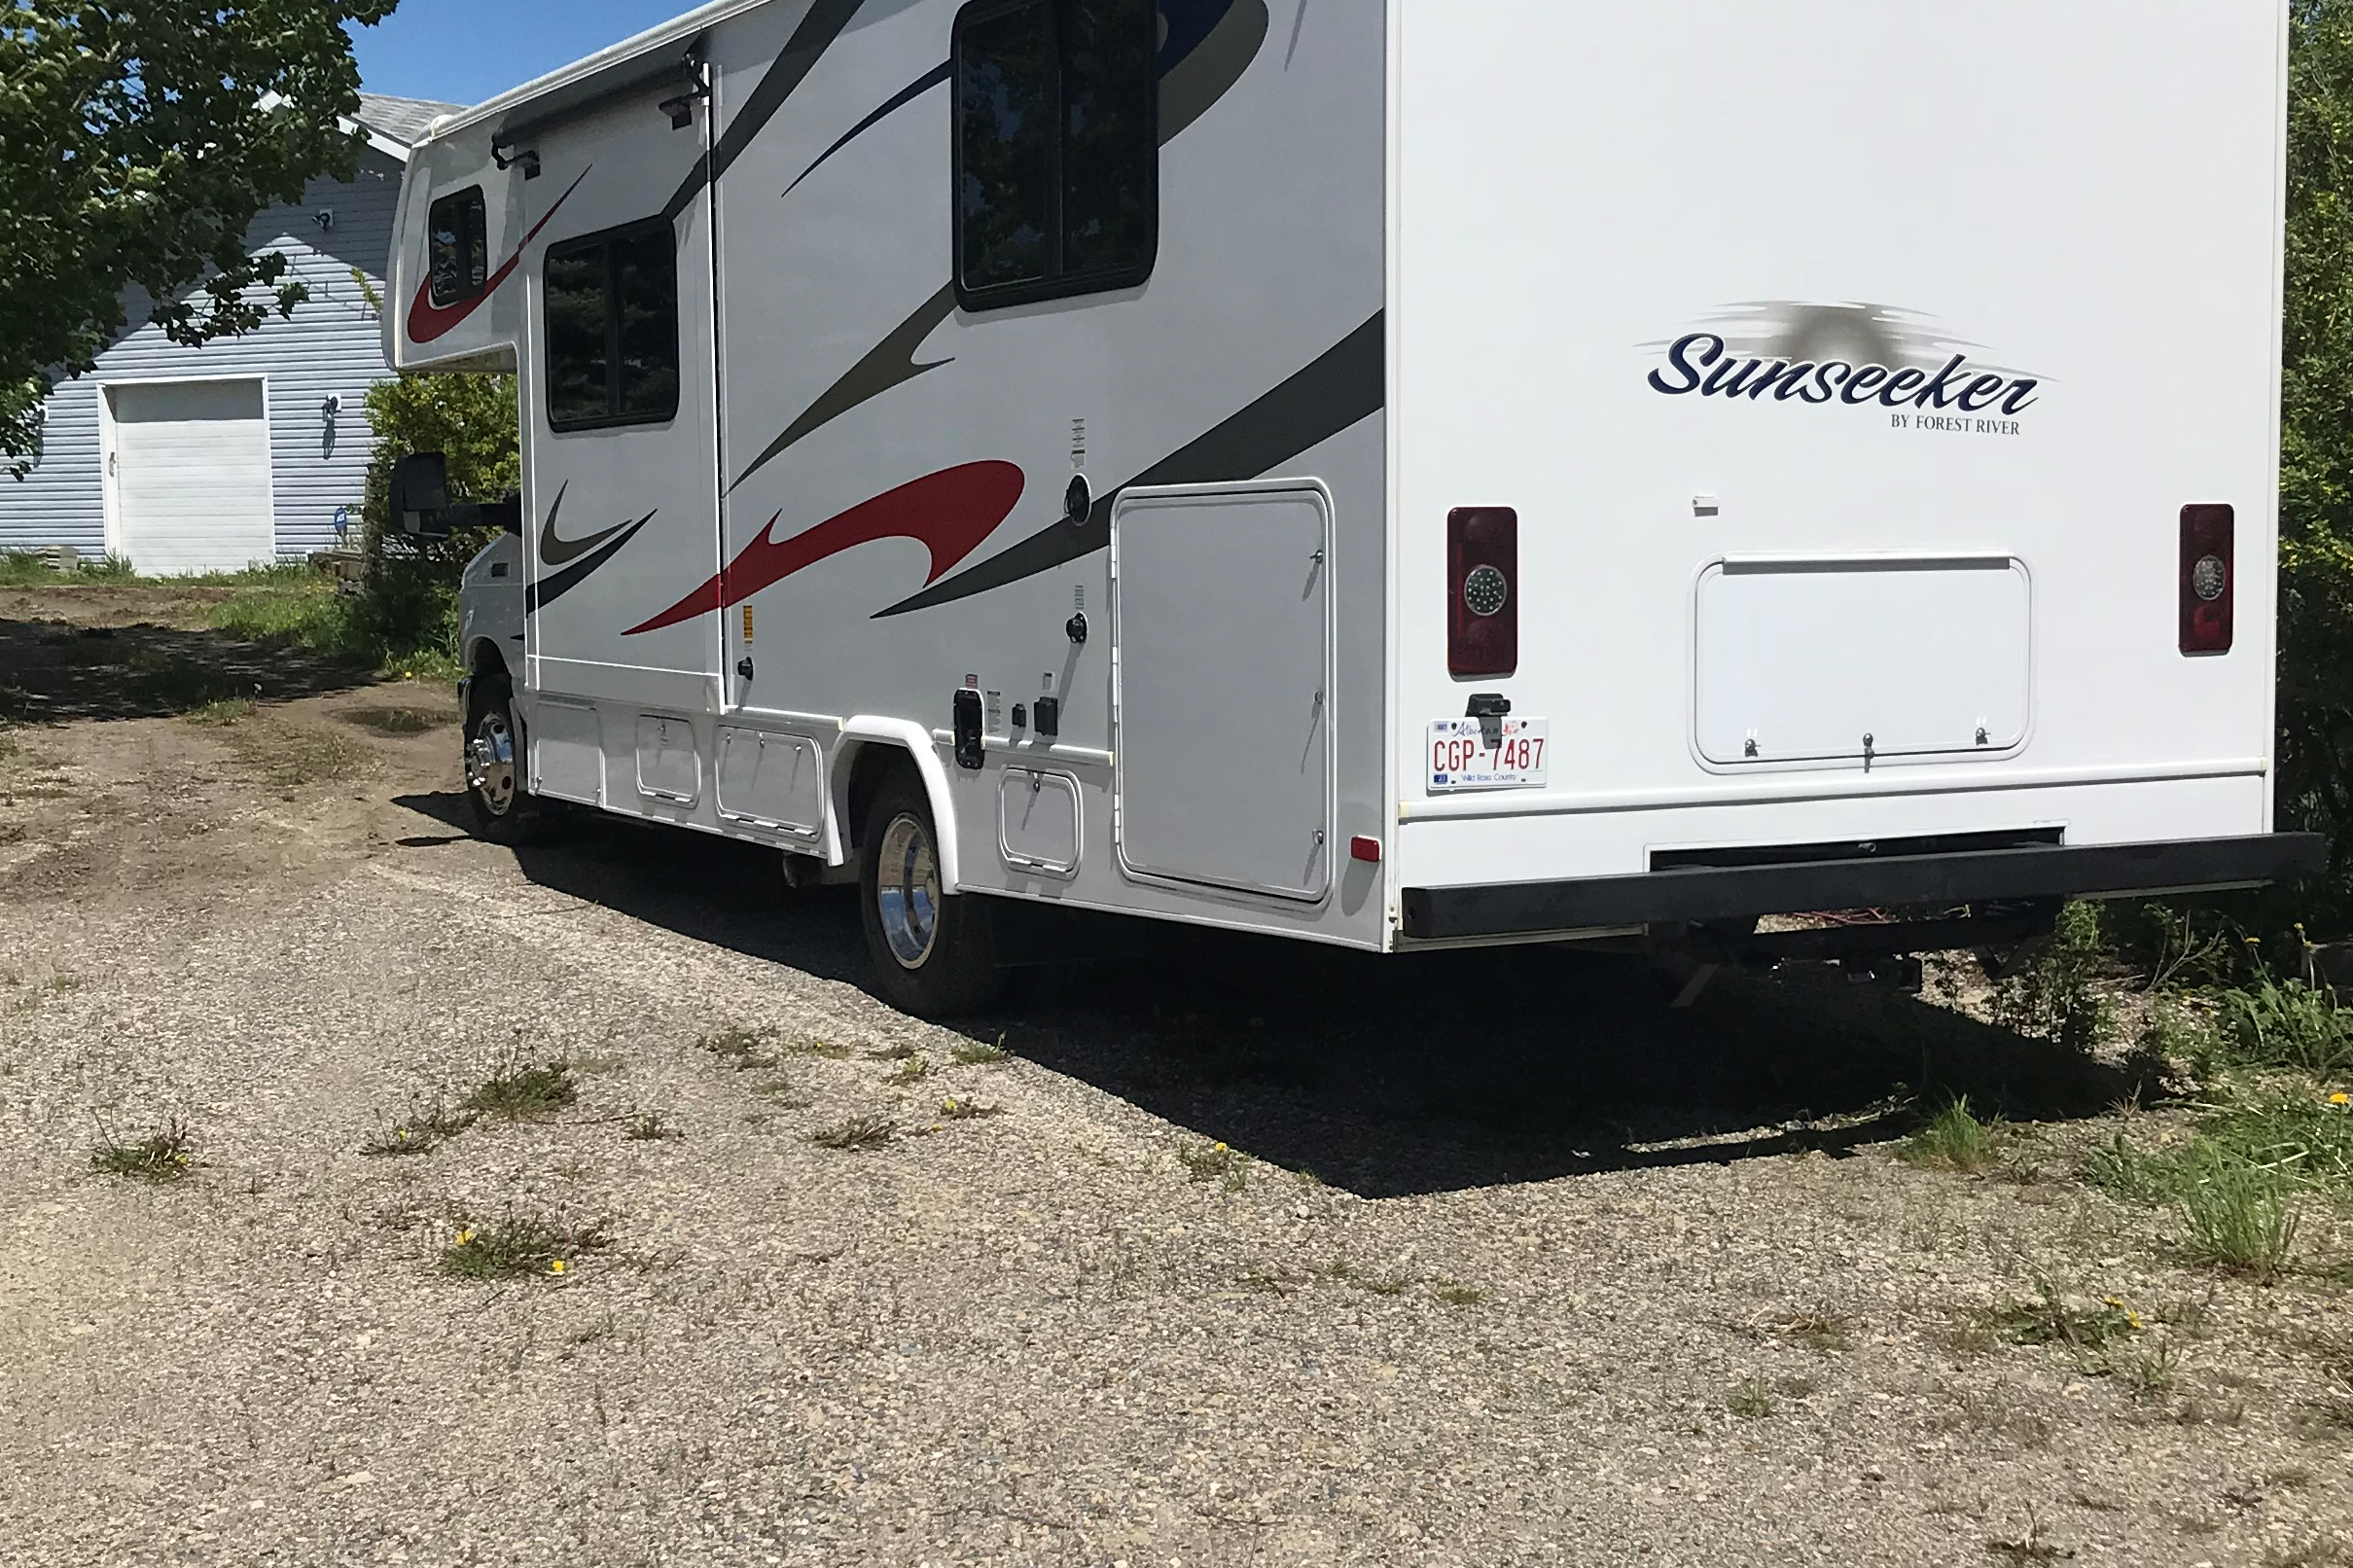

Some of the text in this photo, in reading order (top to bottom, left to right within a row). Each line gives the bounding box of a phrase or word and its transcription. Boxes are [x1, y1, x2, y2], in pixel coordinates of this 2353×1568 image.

[1647, 332, 2040, 416] Sunseeker
[1890, 413, 2020, 436] BY FOREST RIVER
[1433, 737, 1545, 771] CGP-7487
[1493, 772, 1517, 782] County
